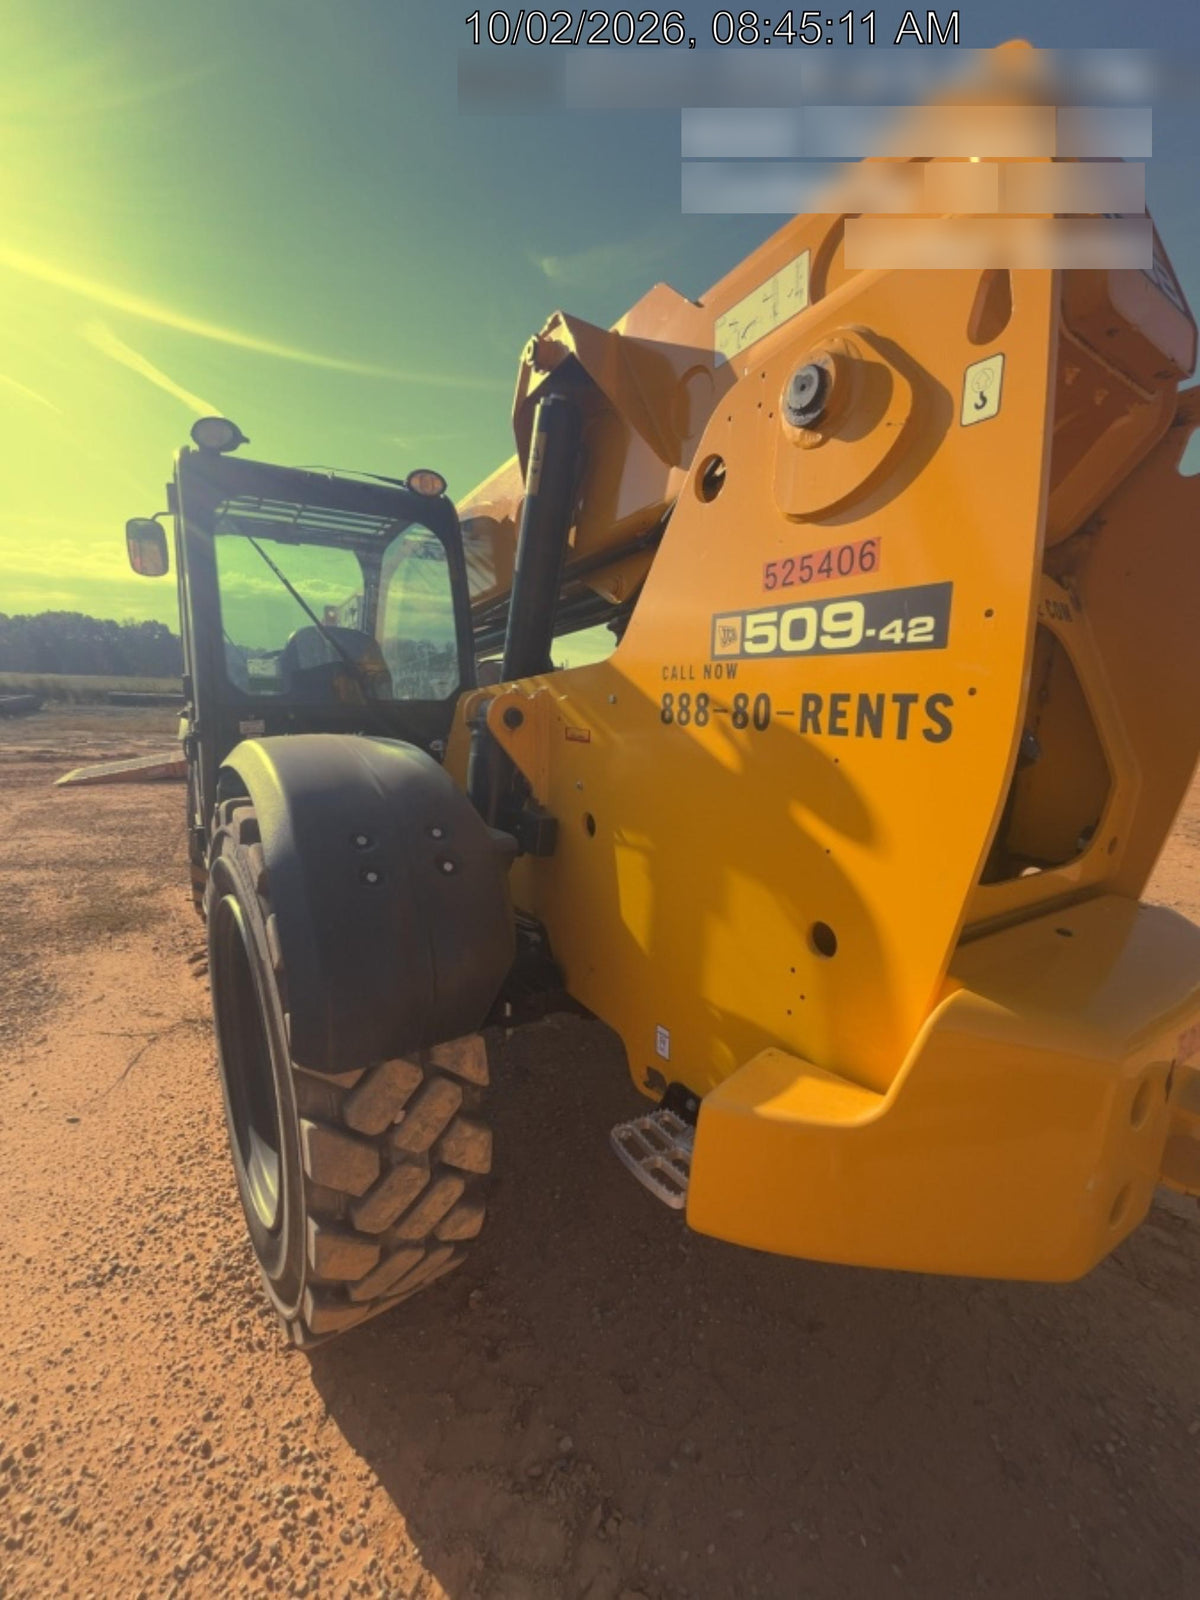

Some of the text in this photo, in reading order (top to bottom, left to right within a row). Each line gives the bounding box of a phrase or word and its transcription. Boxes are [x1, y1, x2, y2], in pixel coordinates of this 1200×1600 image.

[764, 540, 877, 591] 525406
[743, 600, 935, 654] 509-42
[662, 663, 738, 681] CALL NOW
[660, 692, 954, 743] 888-80-RENTS
